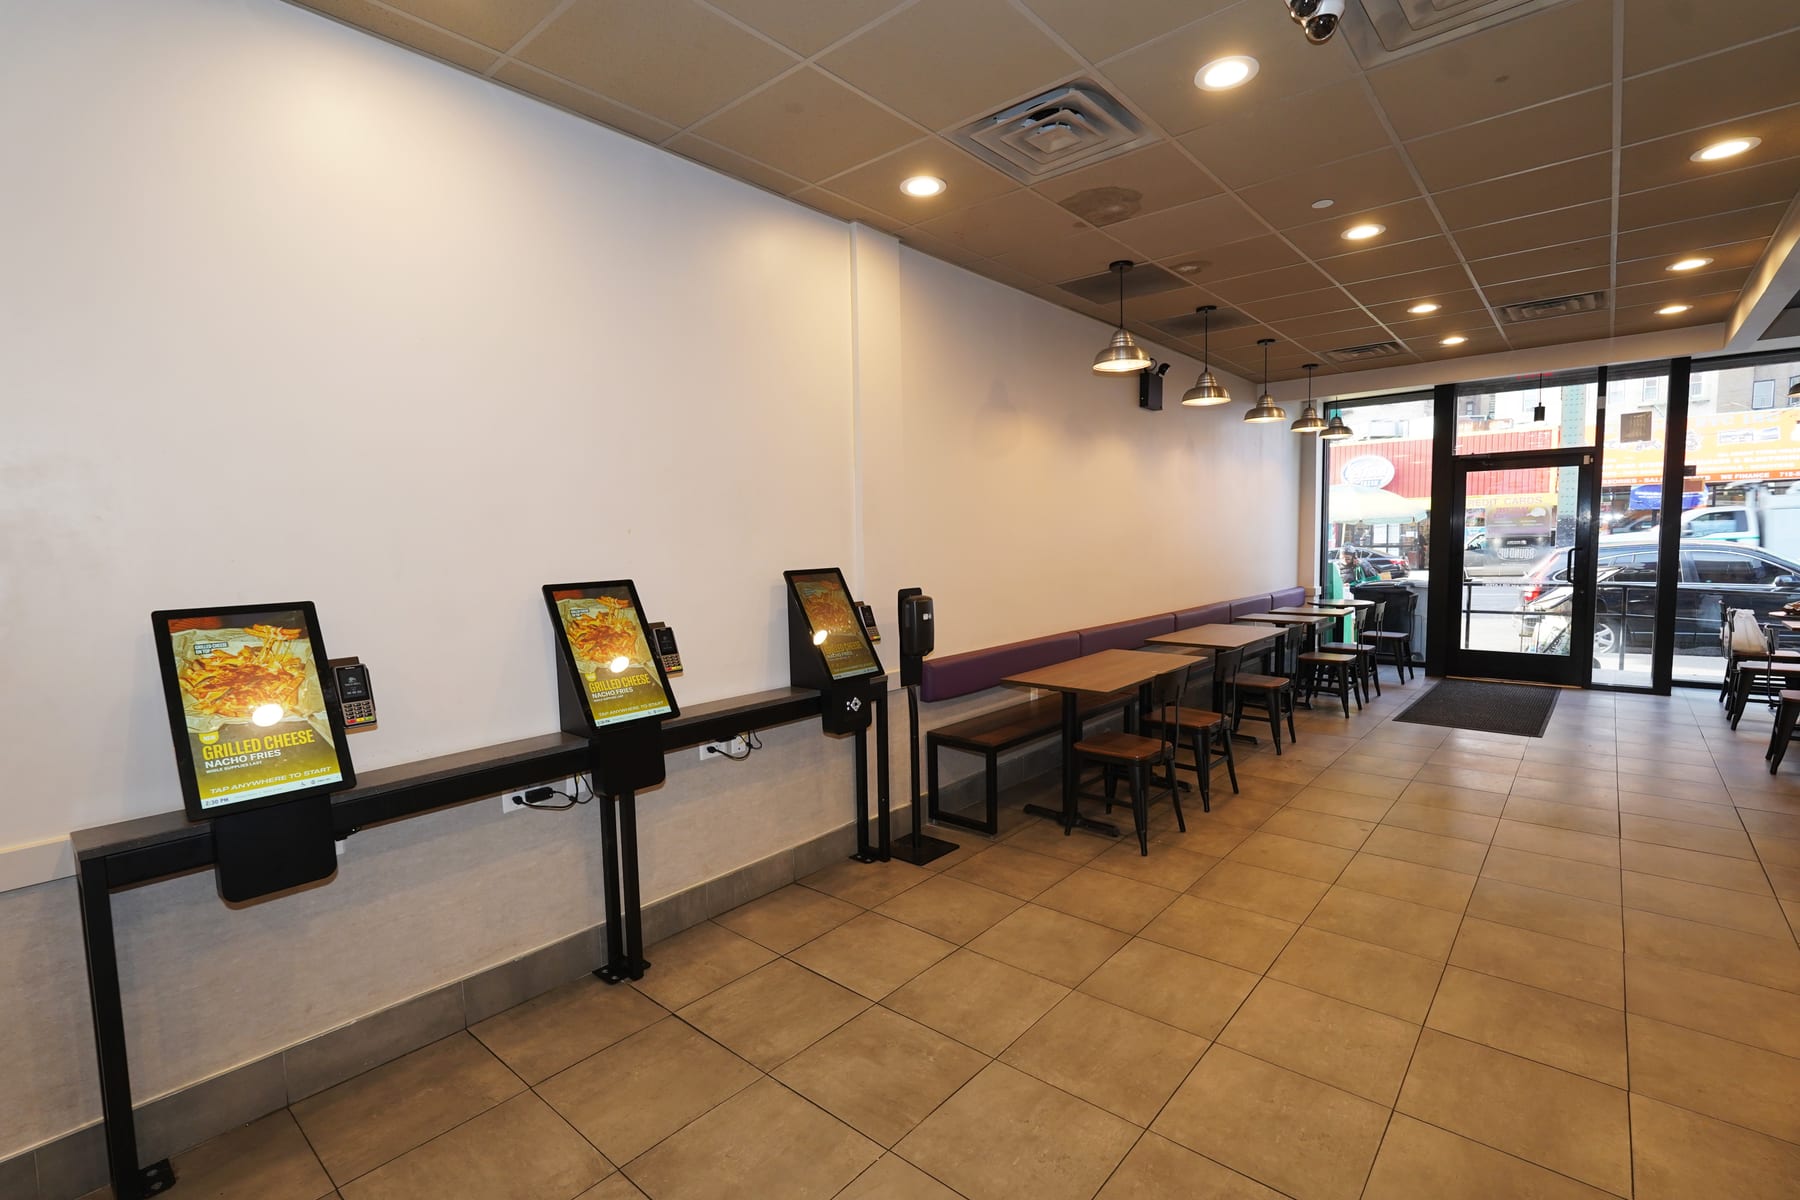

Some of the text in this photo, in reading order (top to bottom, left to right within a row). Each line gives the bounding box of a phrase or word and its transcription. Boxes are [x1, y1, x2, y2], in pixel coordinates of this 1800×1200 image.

[1504, 496, 1542, 505] CARDS
[588, 674, 650, 692] GRILLED CHEESE
[592, 690, 615, 699] NACHO
[202, 729, 315, 761] GRILLED CHEESE
[204, 749, 282, 769] NACHO FRIES
[210, 786, 230, 794] TAP
[231, 775, 287, 790] ANYWHERE
[304, 766, 332, 776] START
